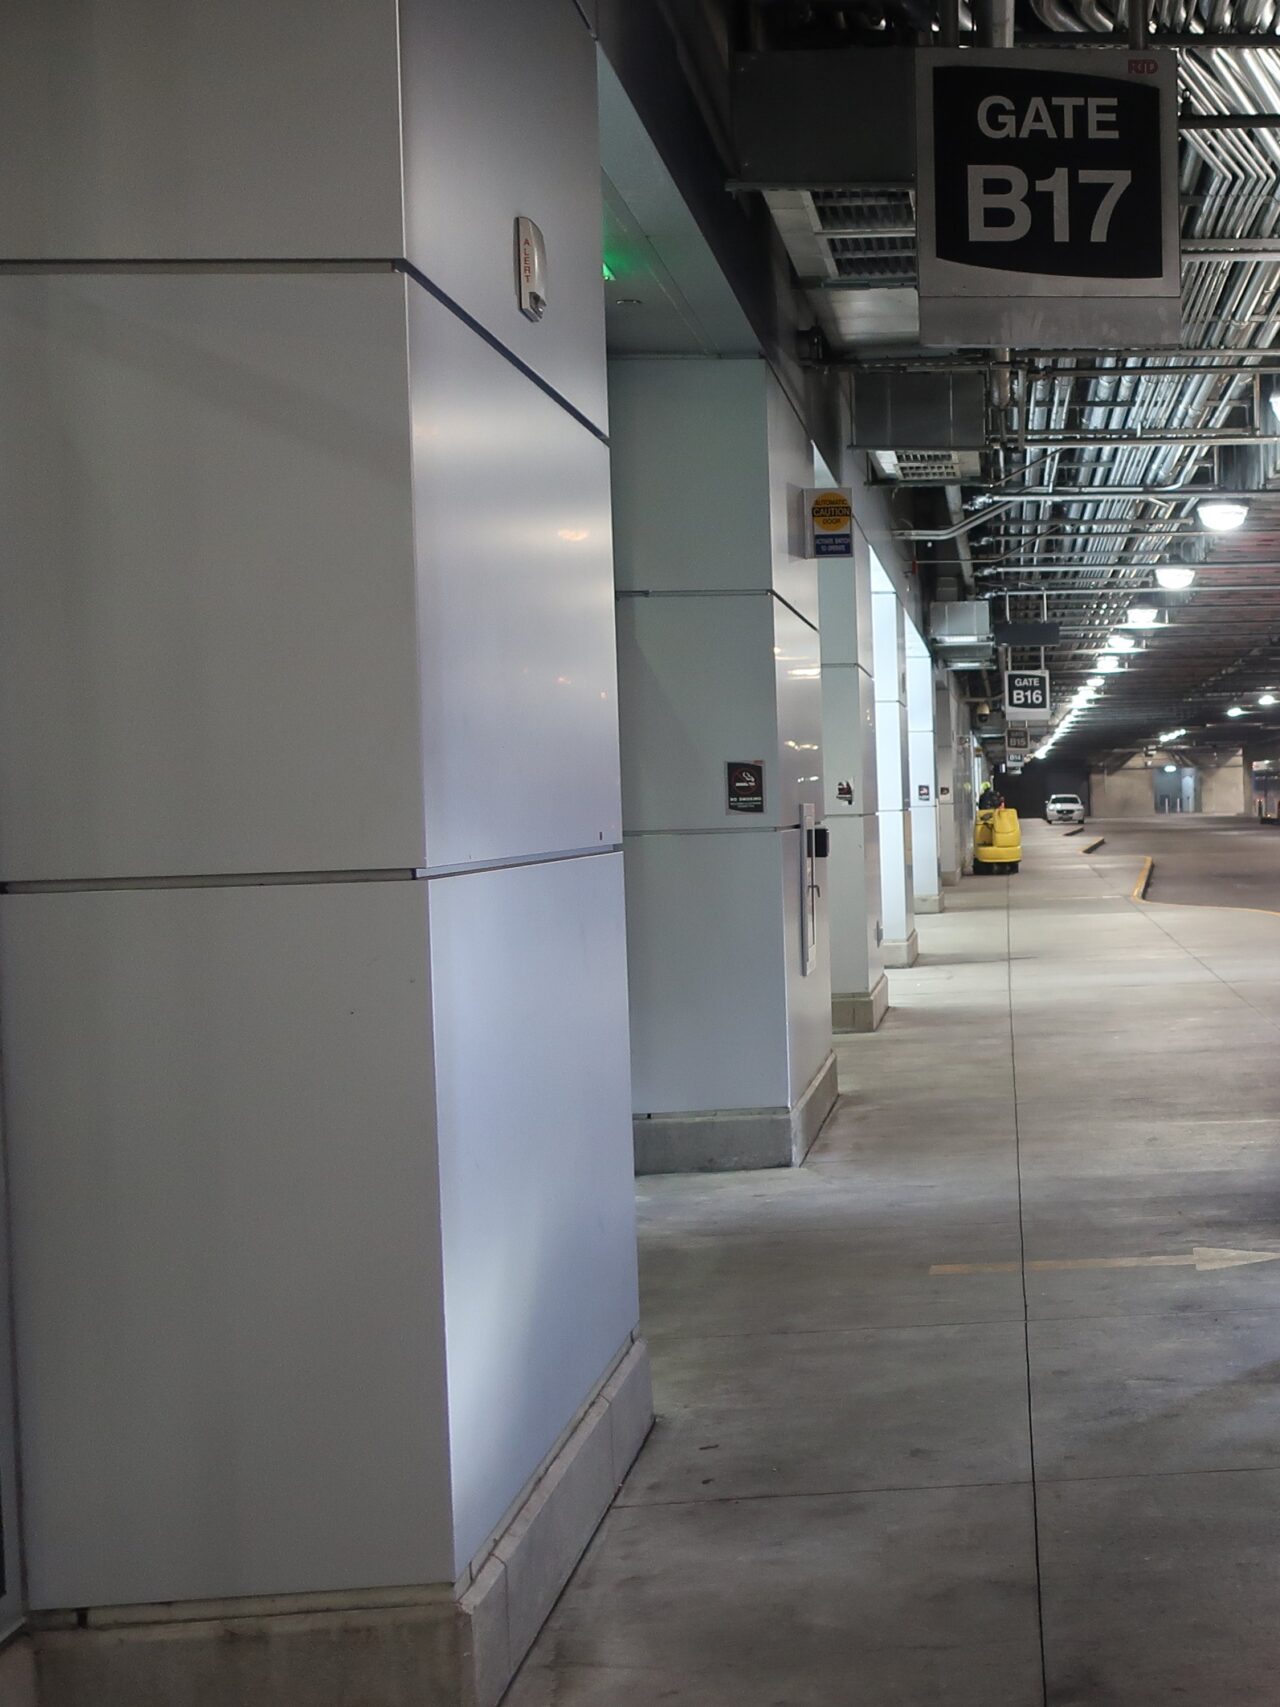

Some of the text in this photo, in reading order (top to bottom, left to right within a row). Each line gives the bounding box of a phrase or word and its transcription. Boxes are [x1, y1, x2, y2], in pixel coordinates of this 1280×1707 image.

[977, 95, 1120, 139] GATE
[967, 164, 1132, 242] B17
[1013, 690, 1043, 704] B16
[1014, 678, 1040, 687] GATE
